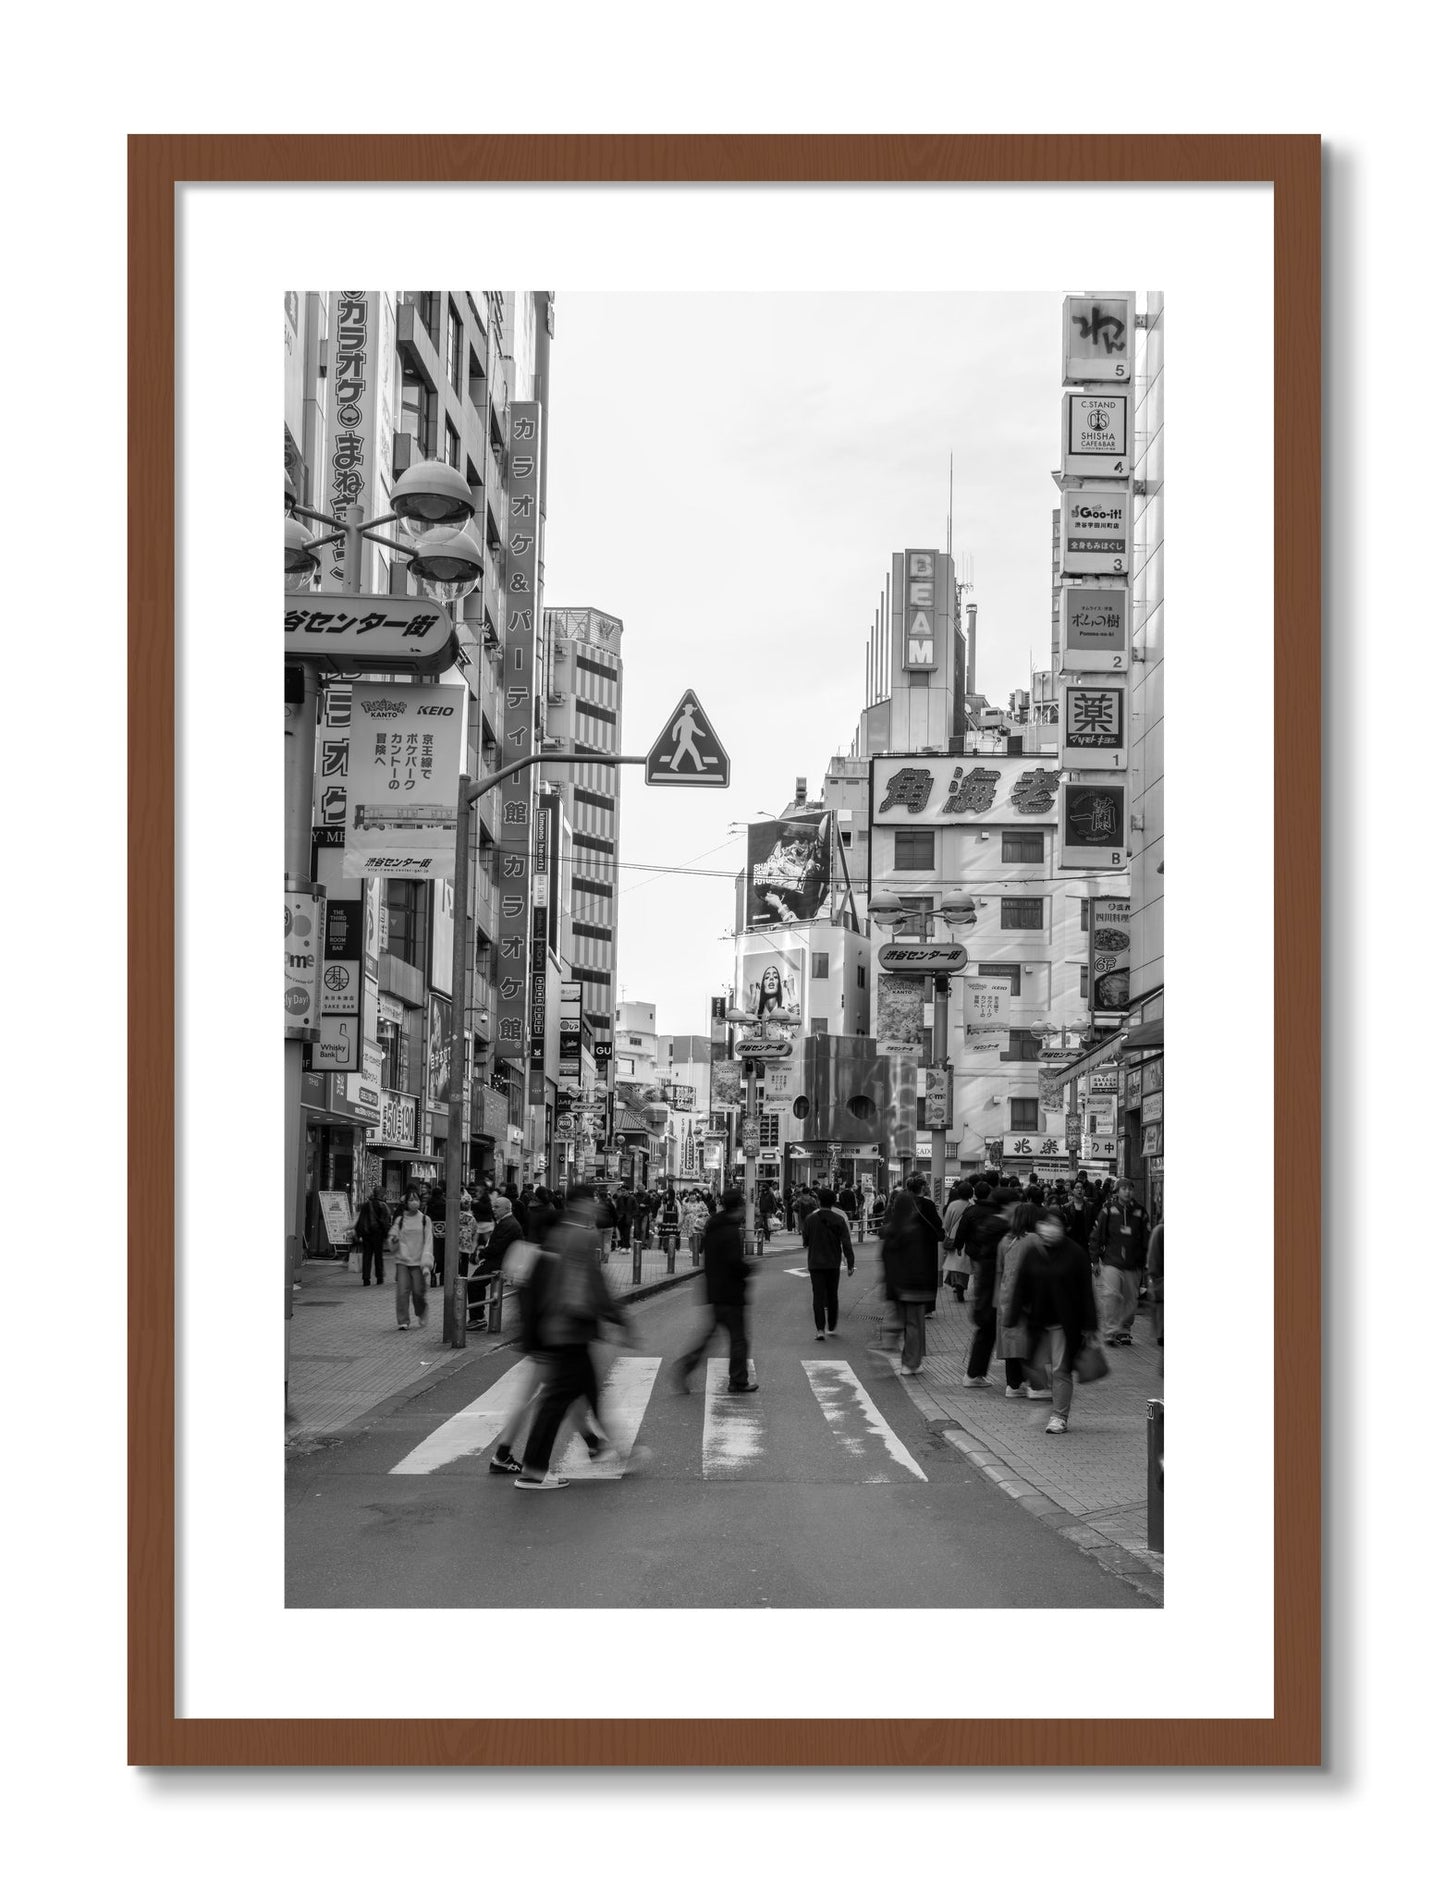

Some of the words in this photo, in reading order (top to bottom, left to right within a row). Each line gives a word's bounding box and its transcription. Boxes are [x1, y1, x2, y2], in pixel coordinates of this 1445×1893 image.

[336, 300, 367, 405] カラオケ
[1115, 364, 1124, 376] 5
[1081, 401, 1116, 409] C.STAND
[1081, 432, 1115, 440] SHISHA
[1114, 461, 1124, 473] 4
[1080, 506, 1122, 519] Goo-it!
[1071, 541, 1123, 550] 全身もみほぐし
[1113, 559, 1122, 571] 3
[909, 554, 934, 664] BEAM
[1071, 613, 1120, 628] ポムの樹
[1113, 656, 1122, 668] 2
[417, 706, 454, 716] KEIO
[1074, 693, 1113, 732] 薬
[374, 733, 387, 765] 冒険へ
[389, 733, 402, 790] カントーの
[404, 733, 418, 790] ポケパーク
[421, 734, 433, 779] 京王線で
[1113, 754, 1120, 767] 1
[878, 767, 1062, 814] 角海老
[1069, 796, 1117, 834] 一蘭
[538, 812, 546, 840] kimono
[365, 858, 433, 868] 渋谷センター街
[1111, 853, 1120, 865] B
[883, 949, 962, 960] 渋谷センター街
[1094, 956, 1117, 973] 6F
[321, 1044, 346, 1053] Whisky
[596, 1046, 612, 1056] GU
[1013, 1138, 1059, 1154] 兆楽
